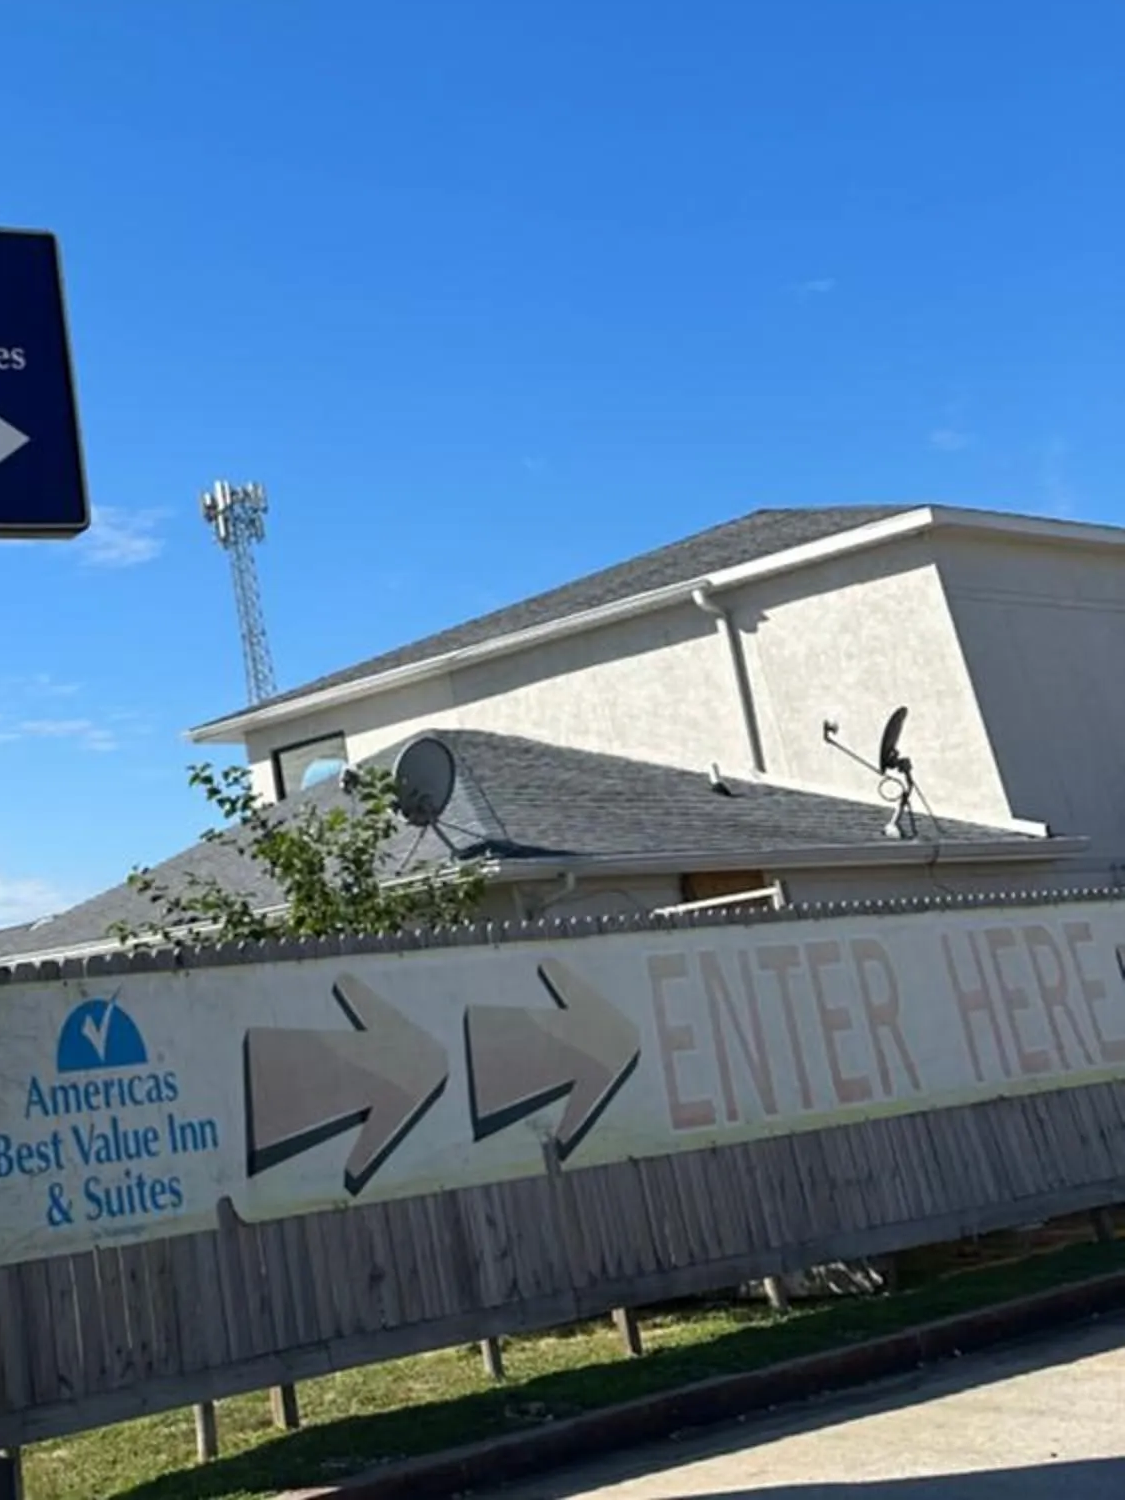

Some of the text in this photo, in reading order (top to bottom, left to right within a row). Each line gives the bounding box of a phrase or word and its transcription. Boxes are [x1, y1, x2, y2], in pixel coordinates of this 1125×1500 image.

[646, 920, 1125, 1132] ENTER HERE
[24, 1070, 179, 1119] Americas
[71, 1115, 160, 1166] Value
[167, 1112, 220, 1151] Inn
[46, 1168, 184, 1227] & Suites
